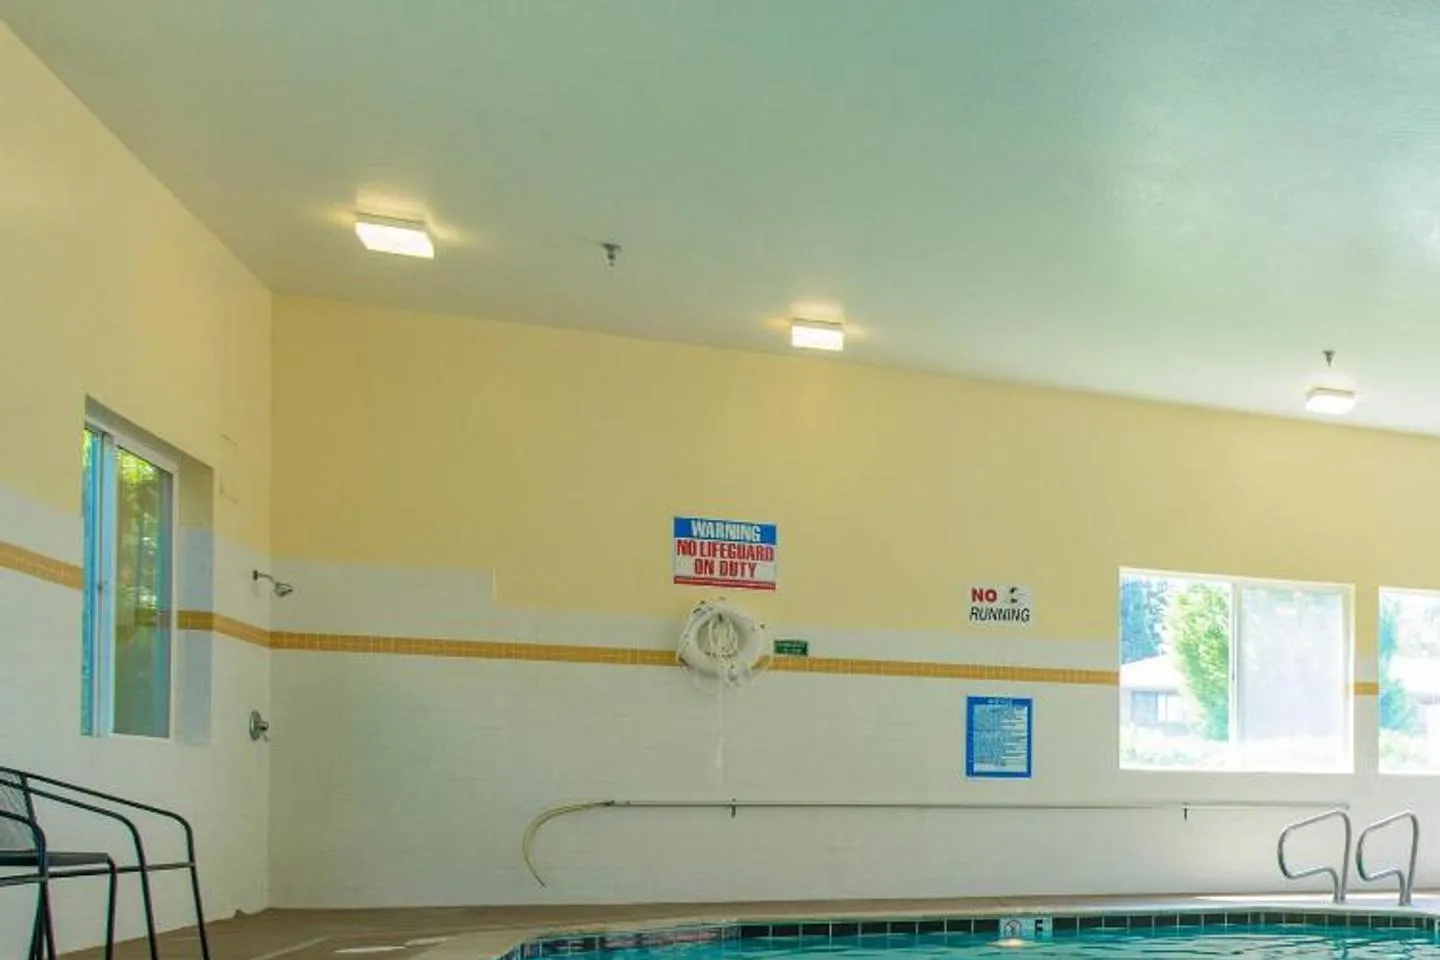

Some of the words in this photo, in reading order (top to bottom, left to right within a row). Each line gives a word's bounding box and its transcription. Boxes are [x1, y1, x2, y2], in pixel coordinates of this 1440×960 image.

[690, 520, 761, 542] WARNING
[676, 539, 697, 557] NO
[700, 541, 775, 562] LIFEGUARD
[694, 558, 714, 575] ON
[719, 560, 757, 578] DUTY
[971, 587, 997, 603] NO
[969, 606, 1030, 622] RUNNING
